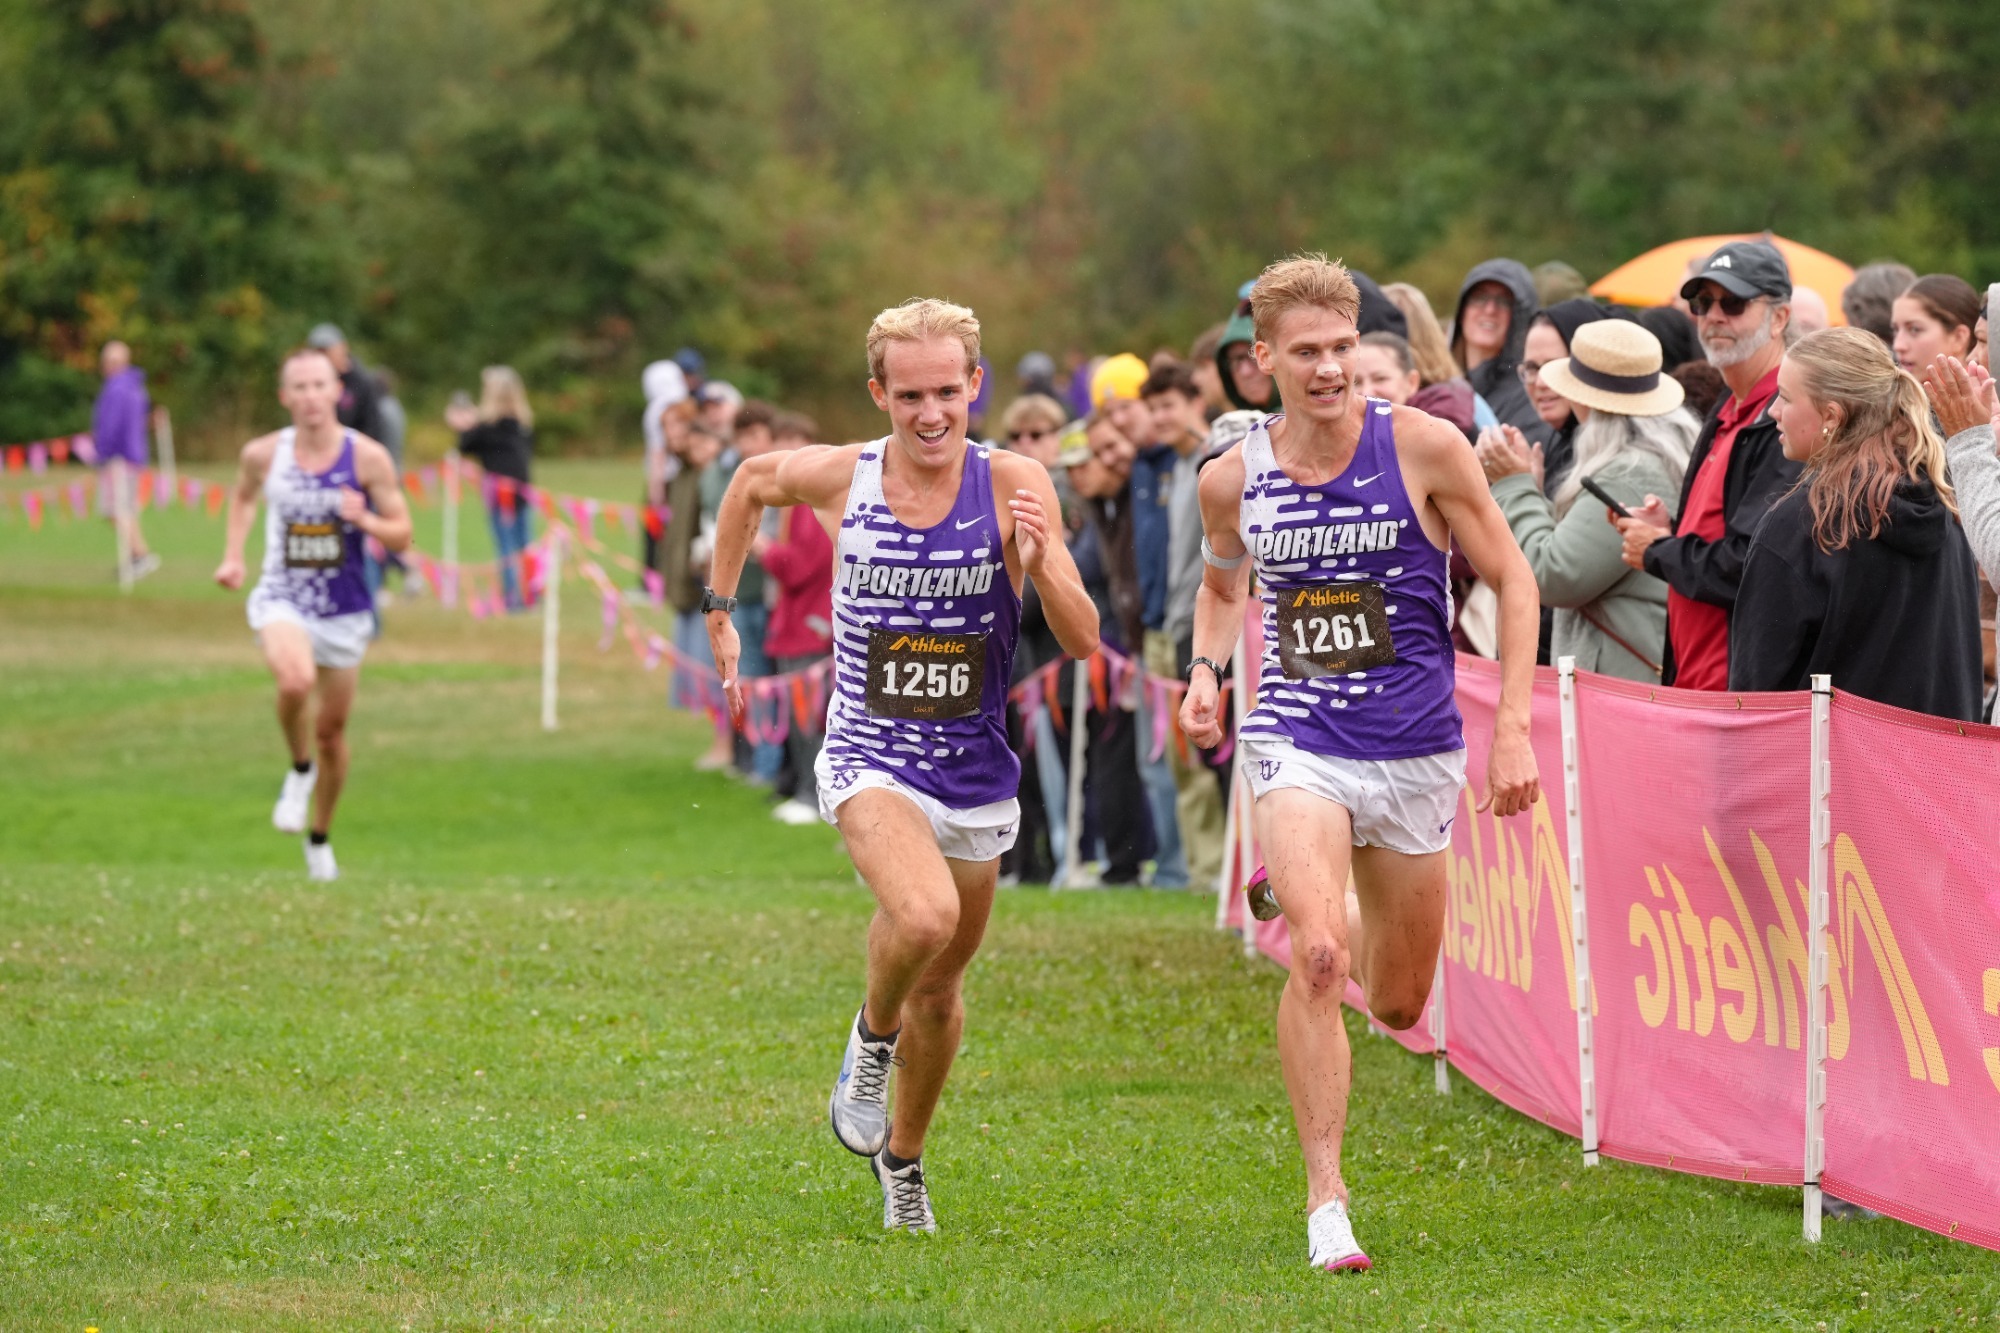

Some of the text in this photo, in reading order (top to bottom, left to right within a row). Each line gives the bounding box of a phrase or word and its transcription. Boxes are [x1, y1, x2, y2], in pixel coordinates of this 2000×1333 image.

[1254, 520, 1400, 562] PORTLAND
[849, 562, 996, 600] PORTLAND
[1292, 589, 1361, 608] Athletic
[889, 635, 966, 654] Athletic
[1292, 613, 1376, 655] 1261
[881, 660, 970, 698] 1256
